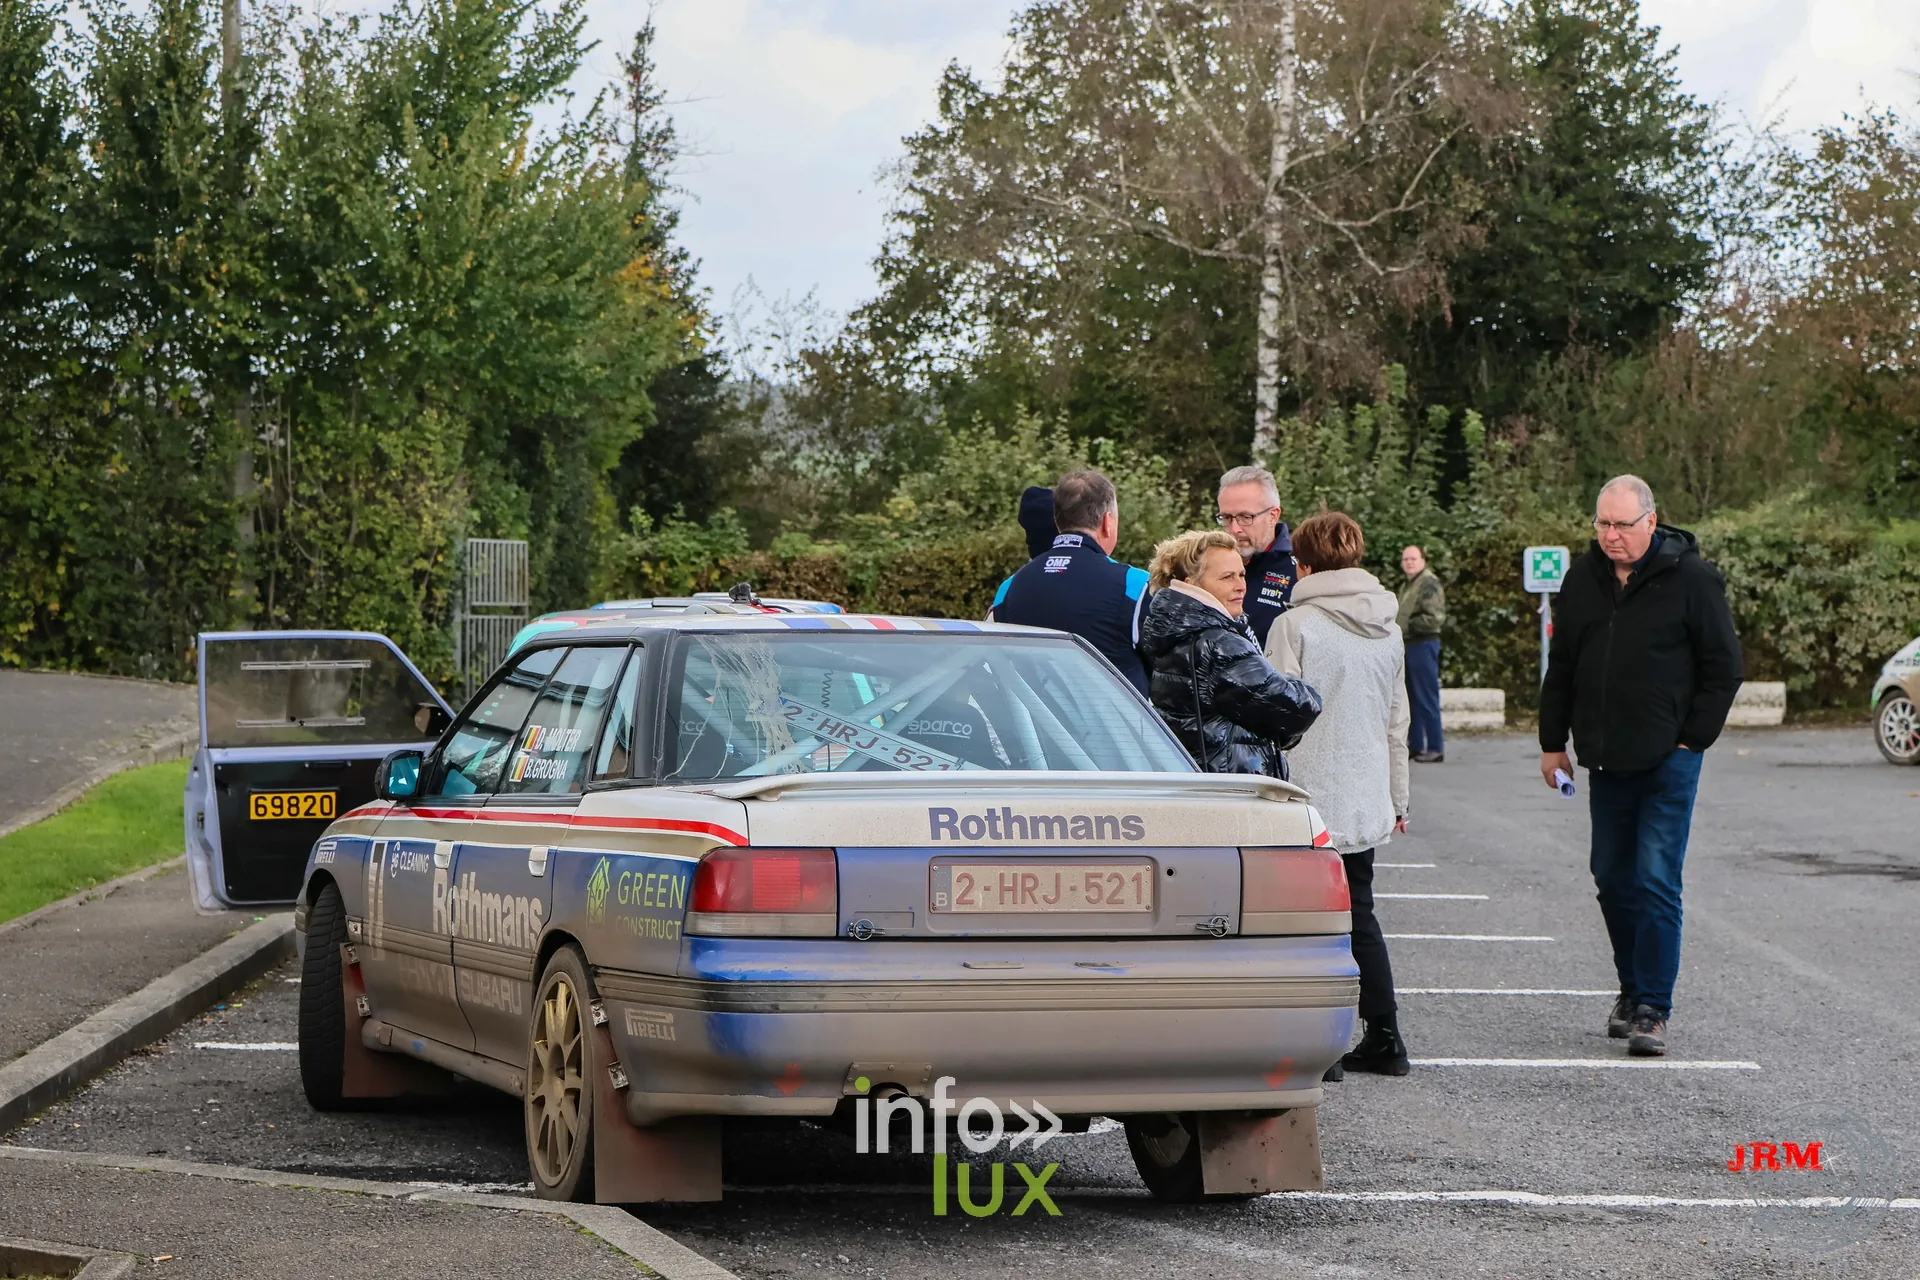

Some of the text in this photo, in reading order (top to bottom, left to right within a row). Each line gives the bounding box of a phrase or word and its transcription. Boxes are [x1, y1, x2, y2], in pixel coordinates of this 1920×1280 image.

[1045, 558, 1071, 567] OMP
[1265, 571, 1291, 581] ORACLE
[1257, 597, 1282, 608] HONDA
[907, 719, 972, 736] sparco
[254, 794, 334, 817] 69820
[928, 807, 1146, 841] Rothmans
[400, 850, 430, 874] CLEANING
[617, 870, 686, 910] GREEN
[935, 872, 1143, 907] B 2-HRJ-521
[432, 868, 544, 949] Rothmans
[616, 915, 682, 941] CONSTRUCT
[460, 969, 523, 1016] SUBARU
[624, 1007, 676, 1042] PIRELLI
